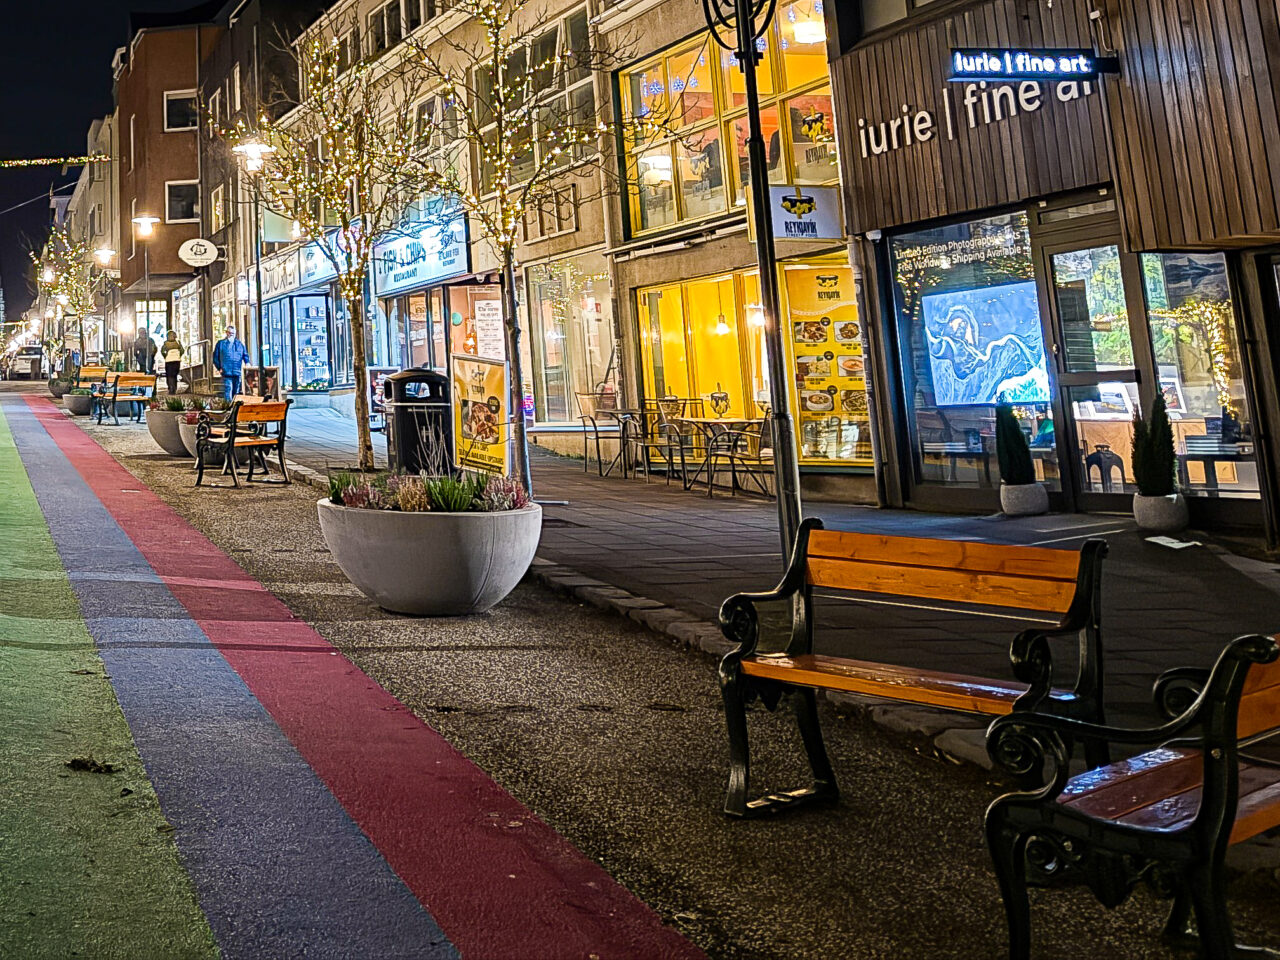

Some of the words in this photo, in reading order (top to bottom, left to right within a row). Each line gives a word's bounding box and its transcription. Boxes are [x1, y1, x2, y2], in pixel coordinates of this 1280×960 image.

[1016, 52, 1055, 72] fine
[1058, 54, 1089, 73] art
[858, 104, 933, 158] iurie
[964, 81, 1042, 129] fine
[922, 244, 947, 256] Edition
[948, 234, 995, 250] Photography
[897, 262, 913, 272] Free
[913, 256, 951, 270] Worldwe
[952, 251, 985, 264] Shipping
[987, 244, 1021, 258] Available
